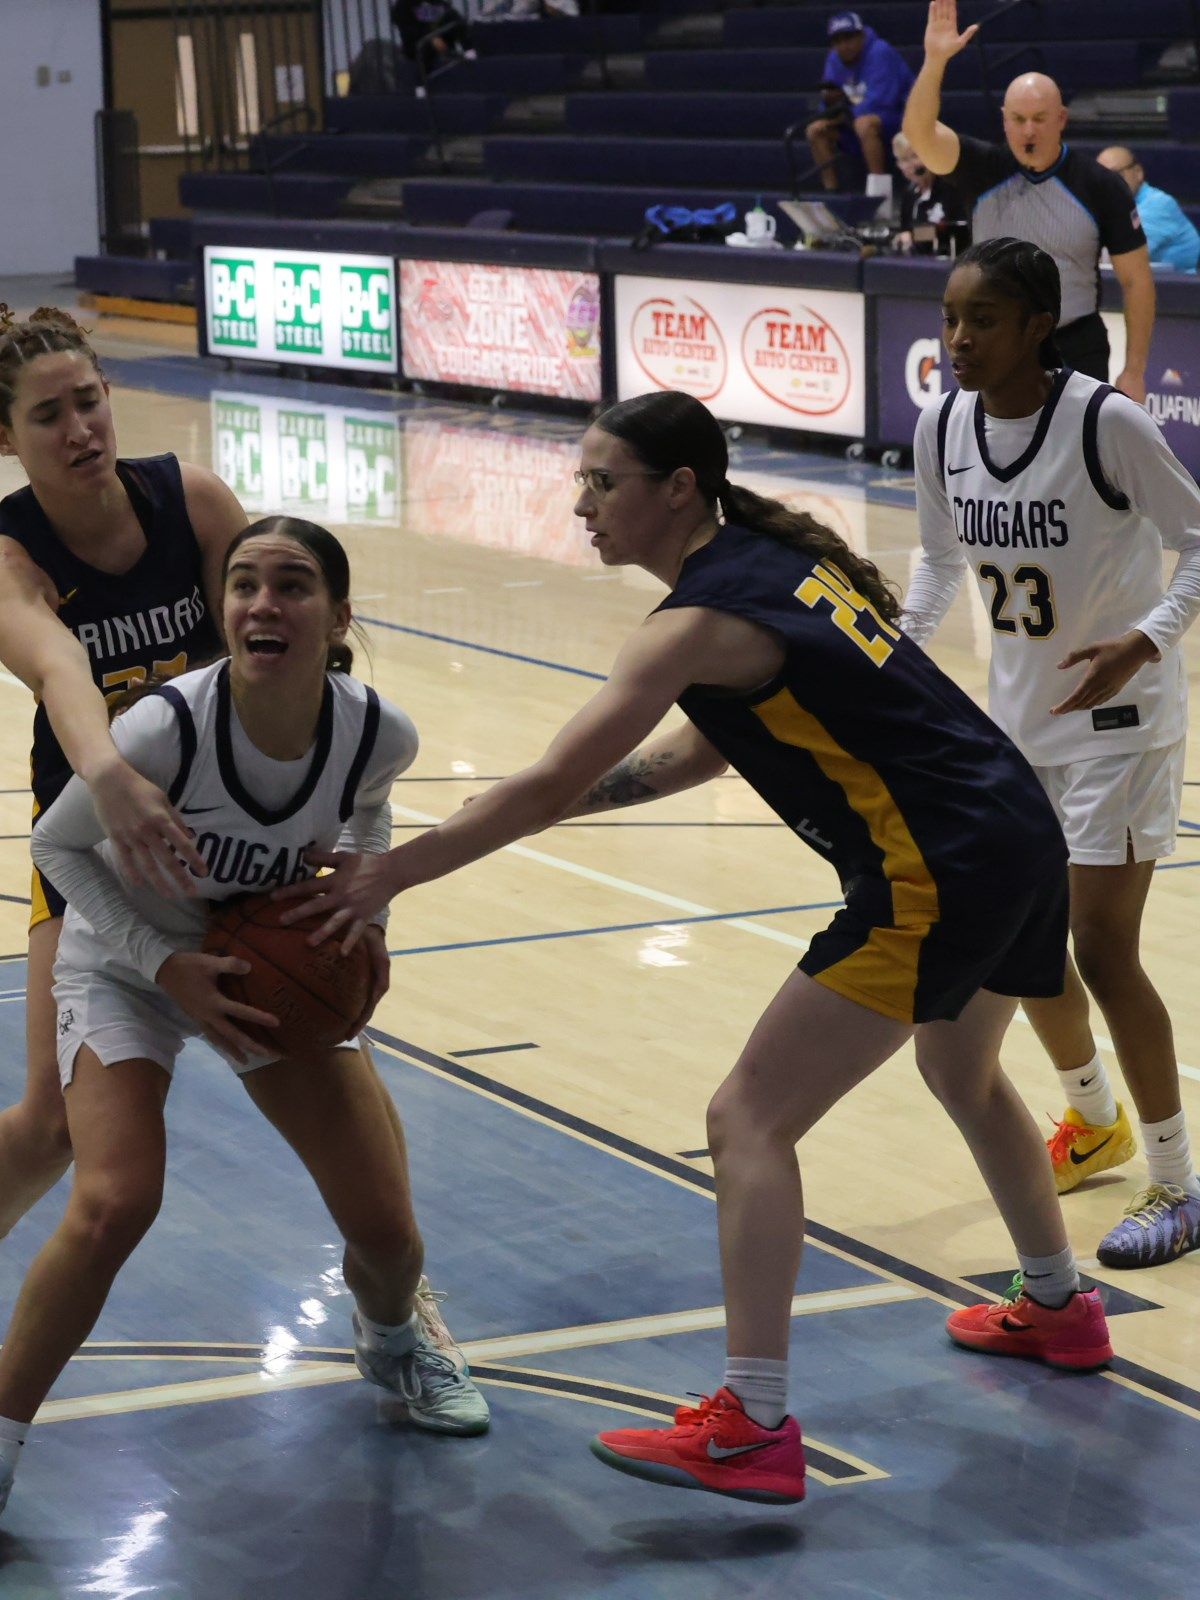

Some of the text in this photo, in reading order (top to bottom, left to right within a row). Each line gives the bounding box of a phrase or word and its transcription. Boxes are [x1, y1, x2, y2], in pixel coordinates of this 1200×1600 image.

[213, 319, 257, 342] STEEL
[275, 324, 322, 352] STEEL
[466, 303, 529, 347] ZONE
[651, 311, 706, 341] TEAM
[766, 322, 827, 353] TEAM
[342, 330, 392, 355] STEEL
[643, 338, 717, 362] AUTO CENTER
[507, 352, 562, 387] PRIDE
[754, 349, 839, 375] AUTO CENTER
[953, 497, 1069, 549] COUGARS
[977, 560, 1058, 640] 23
[70, 584, 205, 660] RINIDAD
